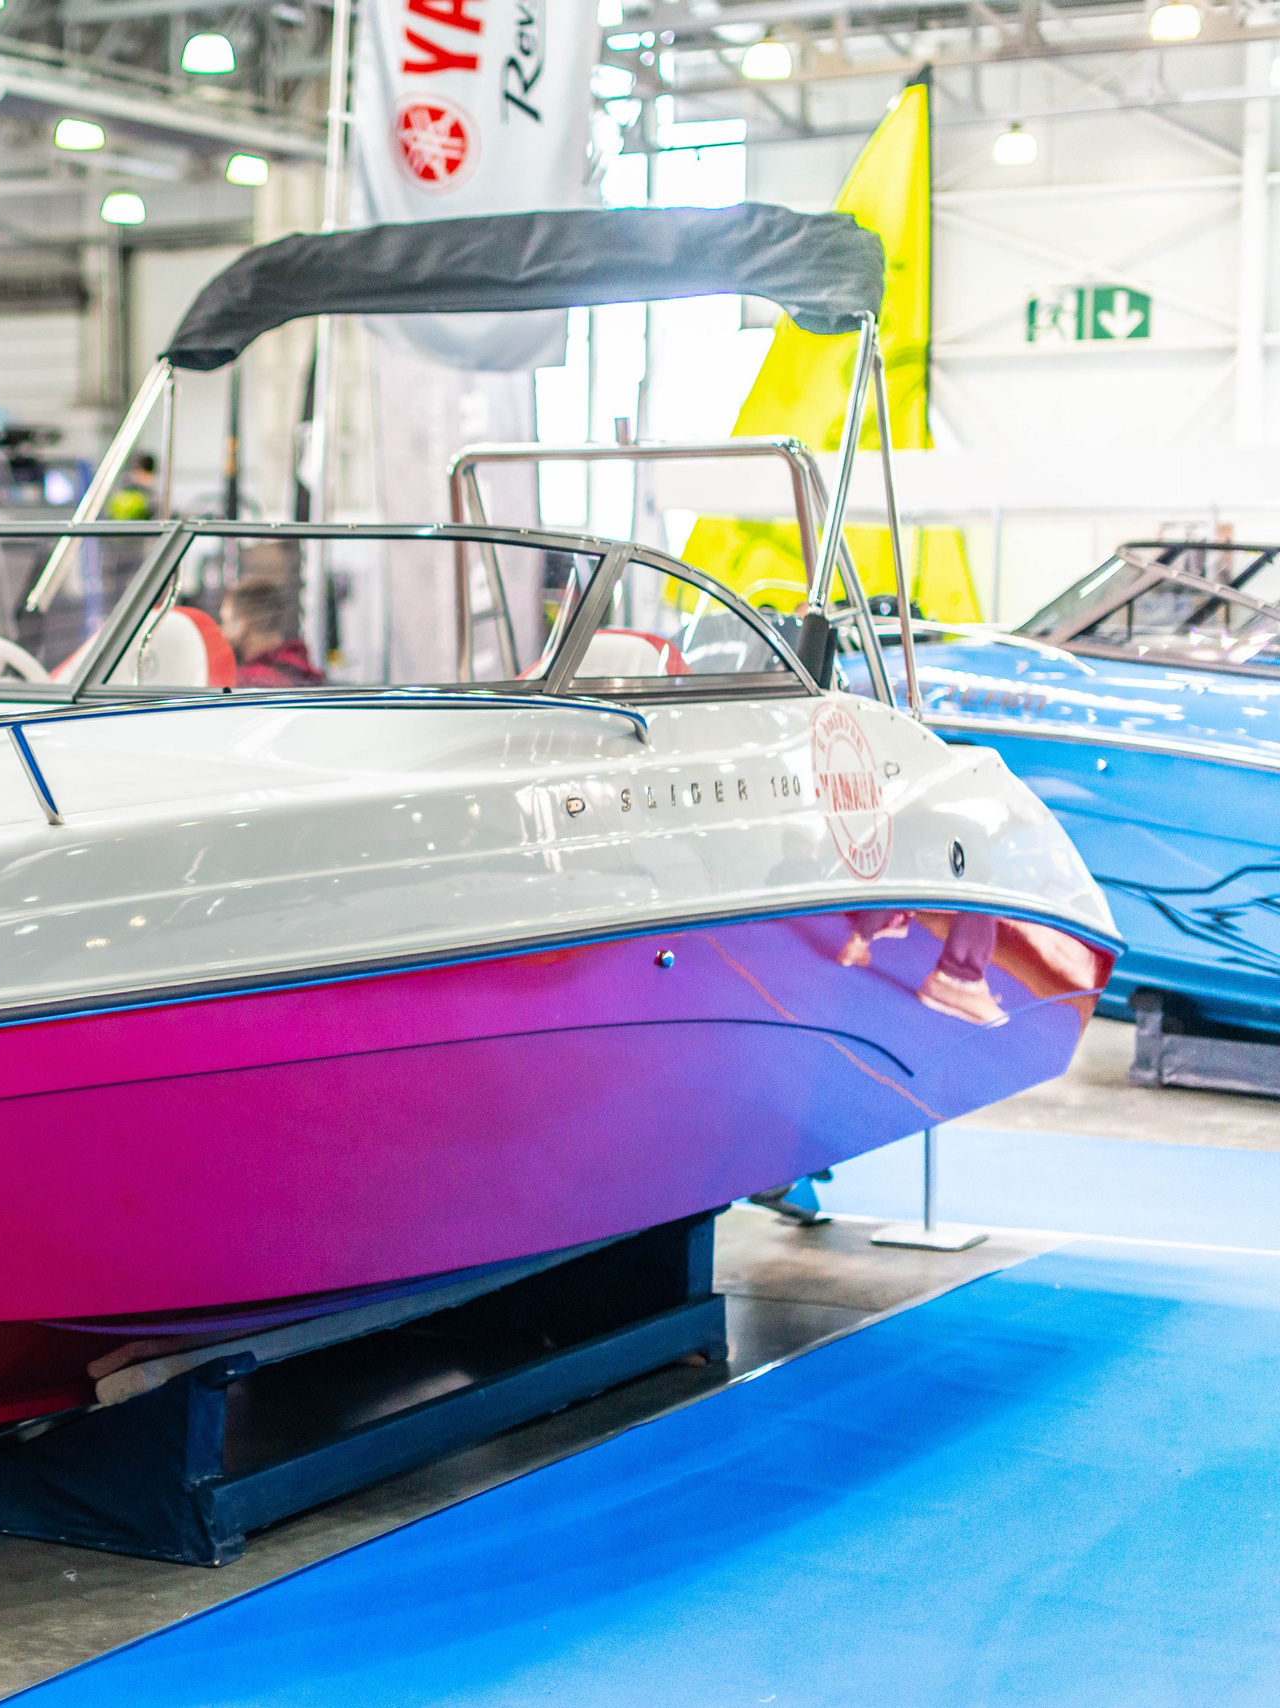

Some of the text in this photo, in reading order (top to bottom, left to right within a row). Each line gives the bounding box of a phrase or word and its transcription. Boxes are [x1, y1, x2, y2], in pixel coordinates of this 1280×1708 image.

[403, 0, 483, 74] YA
[620, 774, 802, 813] SLIDER 180
[819, 770, 880, 813] YAMAHA
